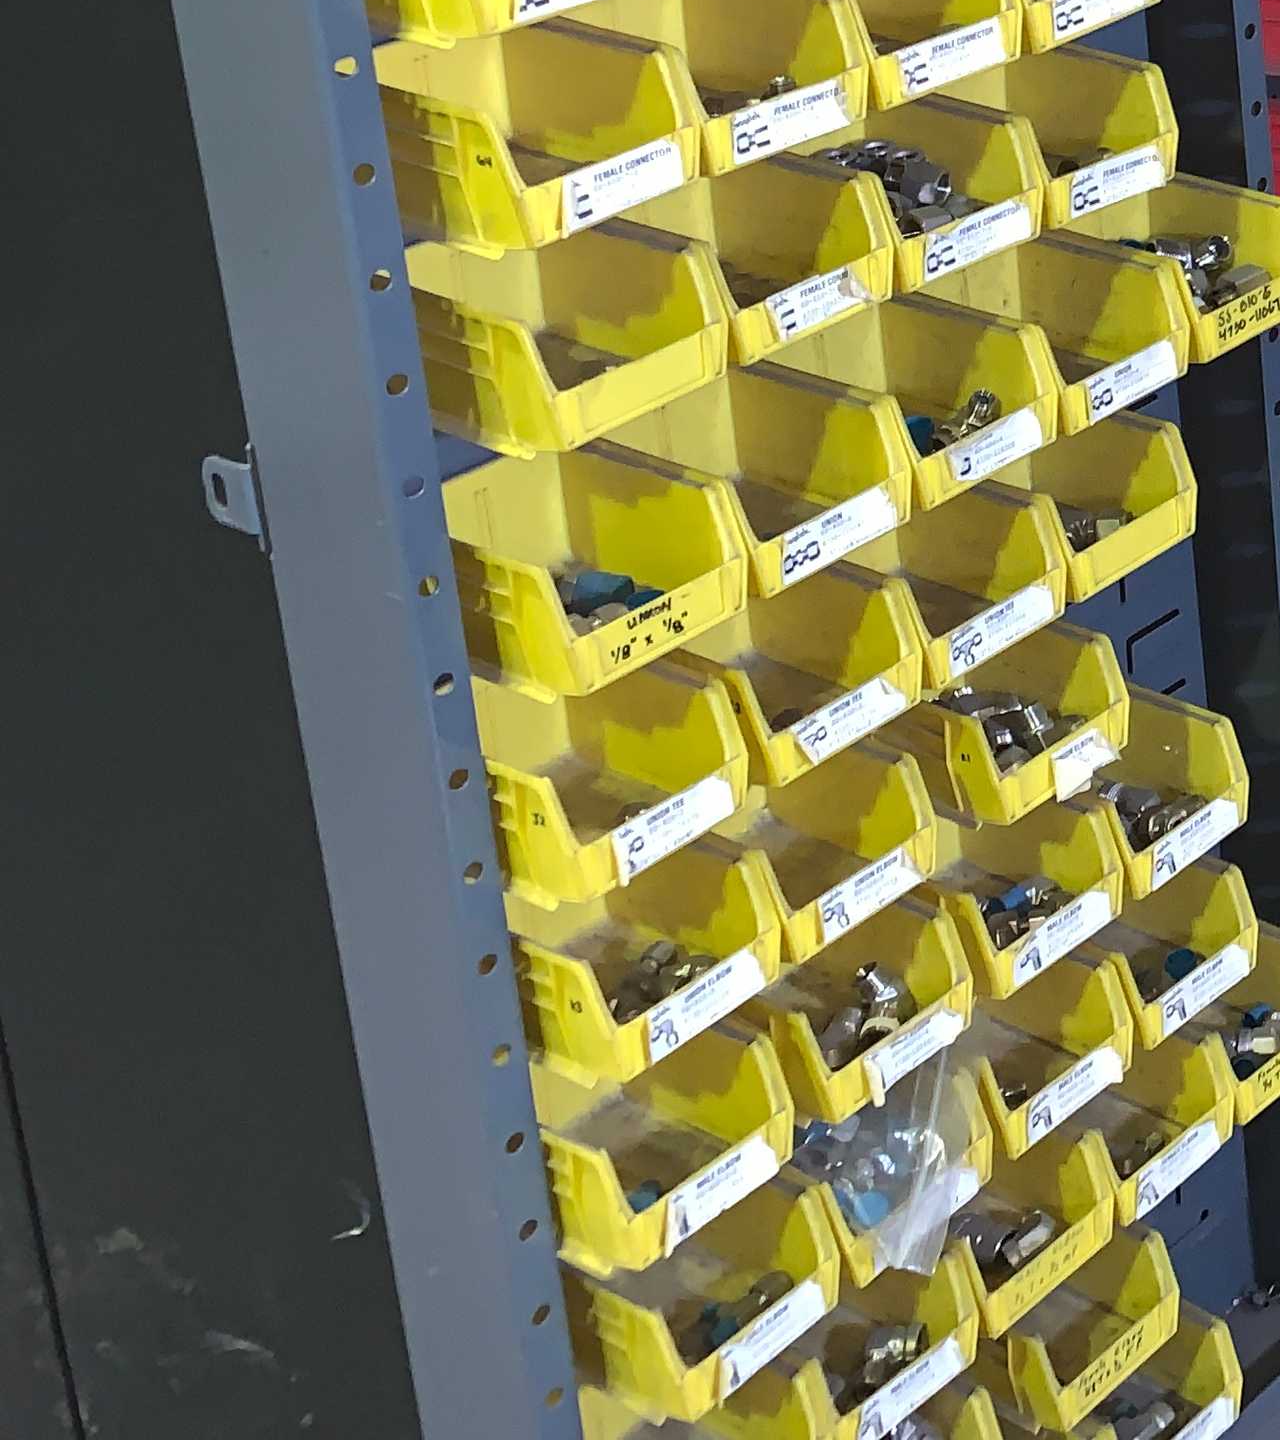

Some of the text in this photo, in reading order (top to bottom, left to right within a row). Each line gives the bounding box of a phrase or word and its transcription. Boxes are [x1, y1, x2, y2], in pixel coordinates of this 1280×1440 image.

[821, 512, 843, 528] UNION
[646, 797, 685, 826] UNION TEE
